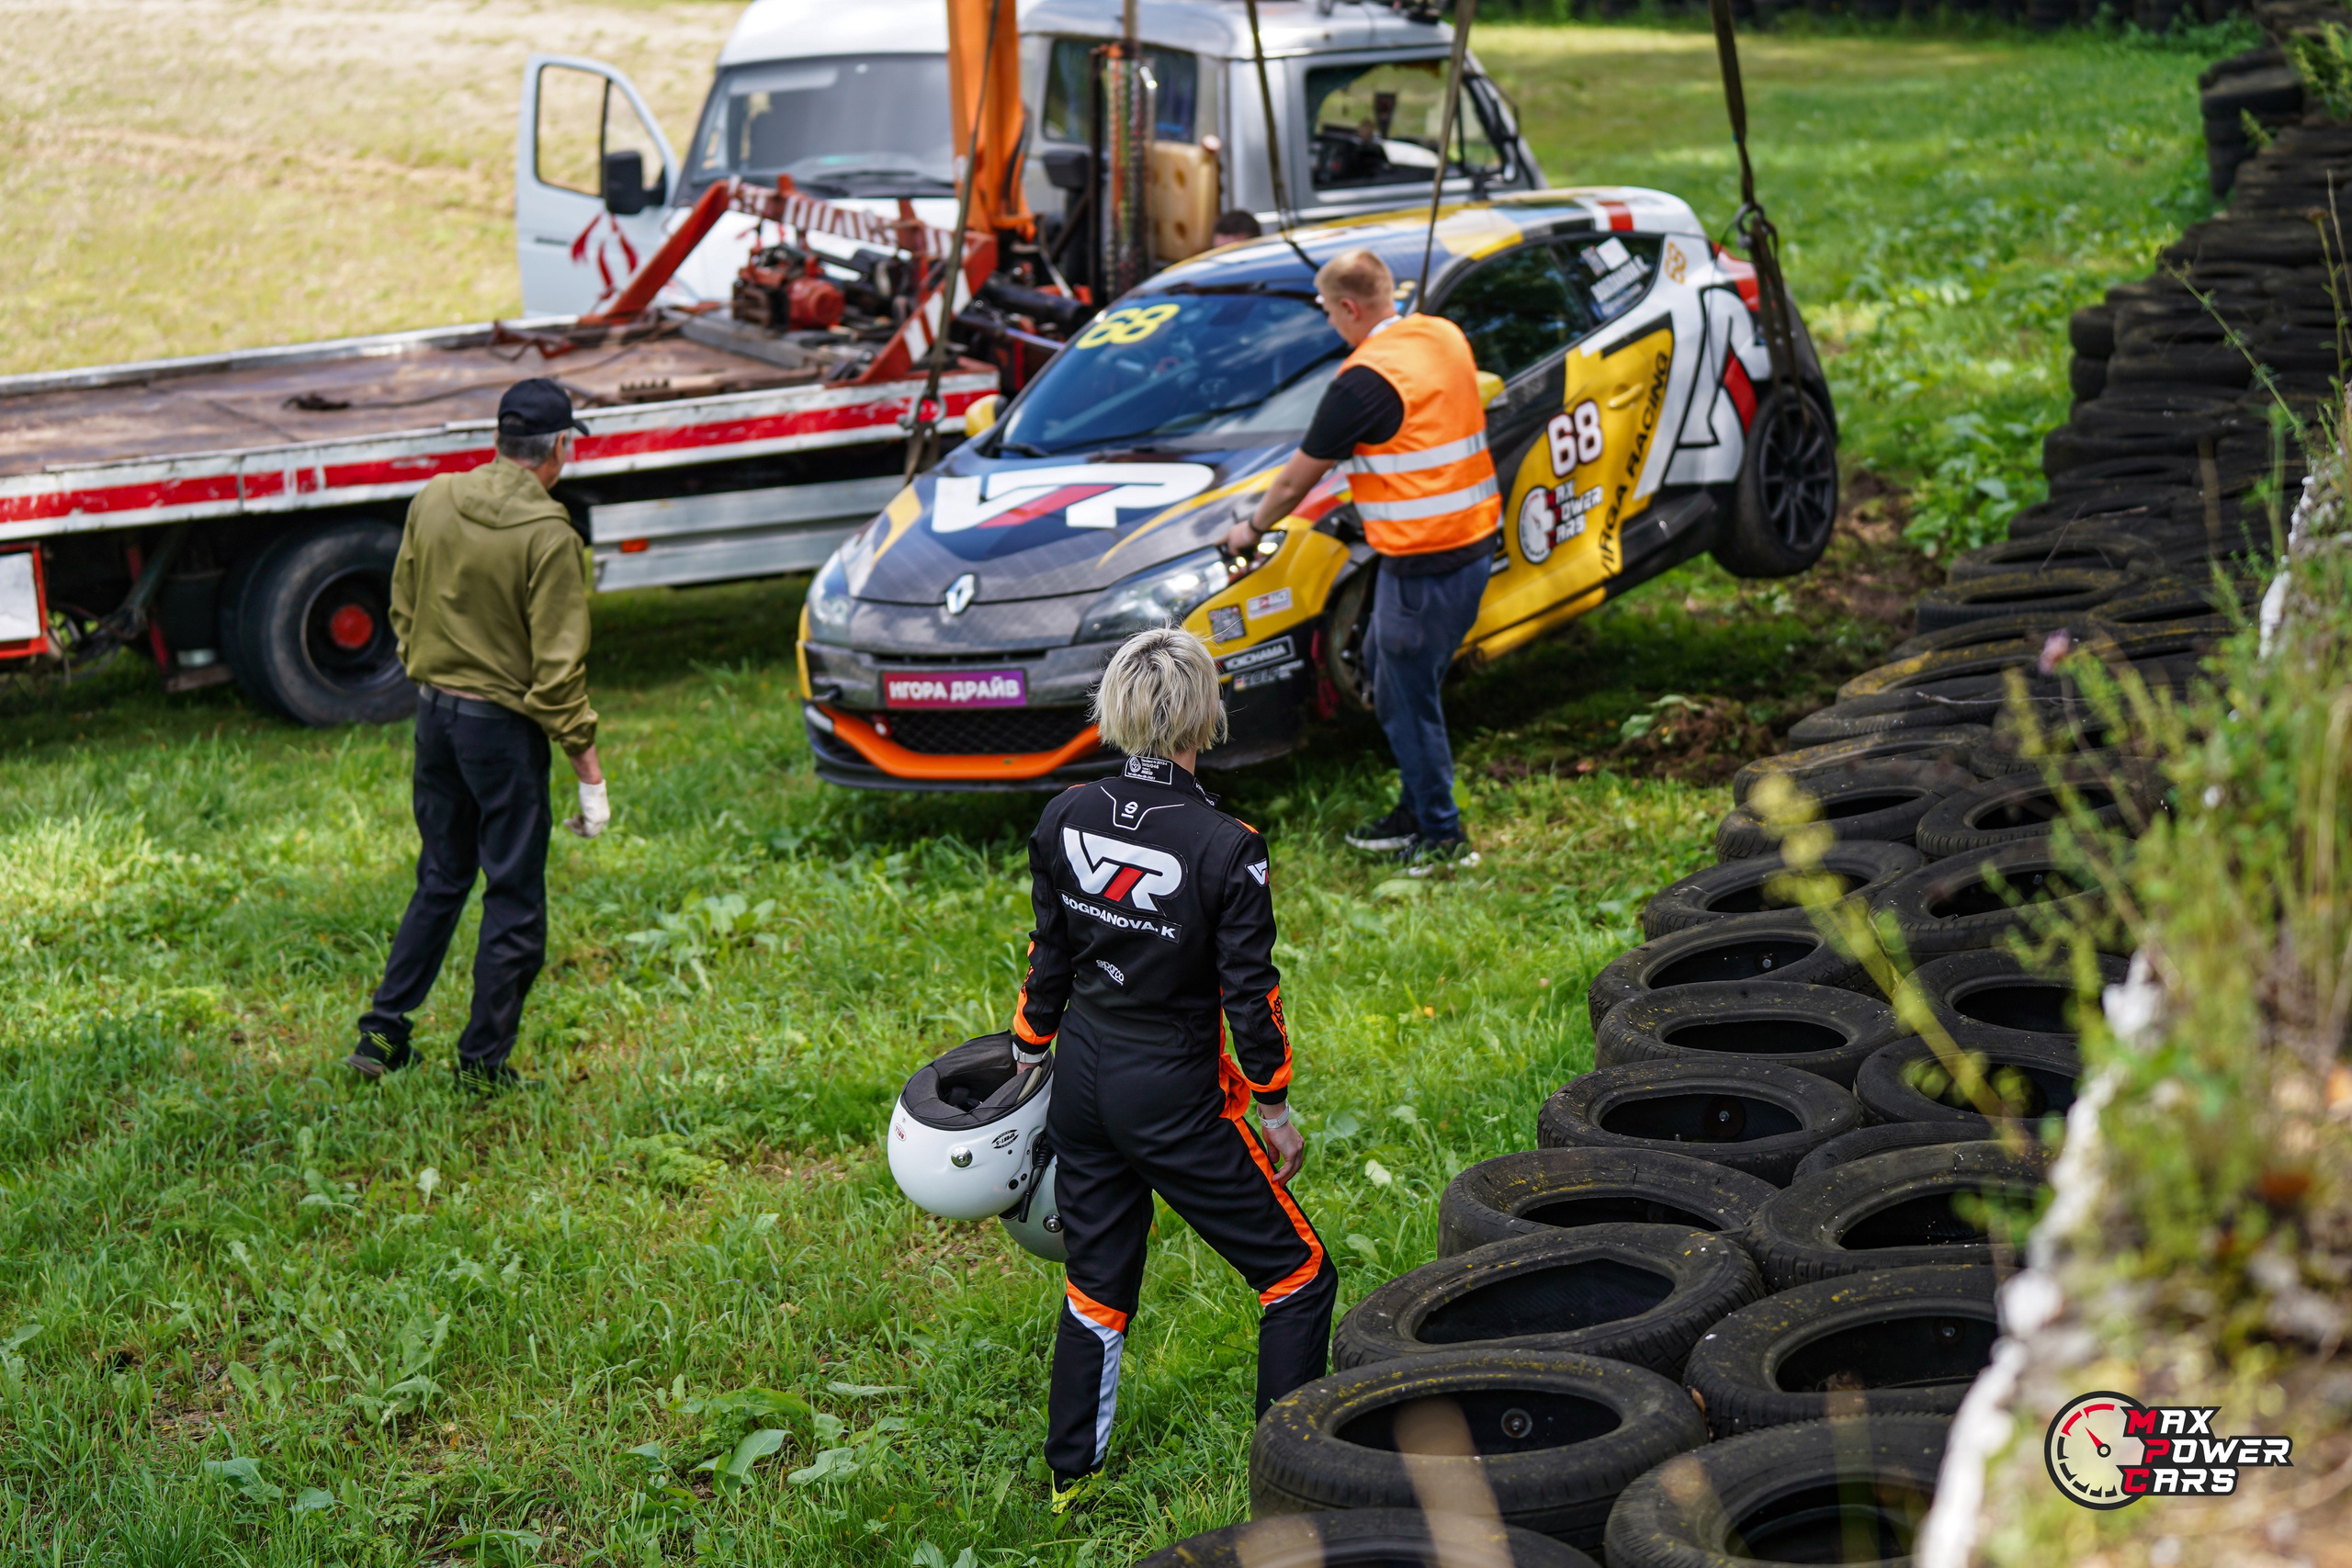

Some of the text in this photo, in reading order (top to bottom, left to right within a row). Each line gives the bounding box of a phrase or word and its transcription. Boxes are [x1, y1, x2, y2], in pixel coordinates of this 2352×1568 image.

[1076, 303, 1181, 349] 68
[1626, 351, 1669, 478] RACING
[1547, 400, 1603, 477] 68
[1554, 485, 1603, 526] POWER
[1224, 644, 1287, 671] YOKOHAMA
[888, 675, 1021, 703] ИГОРА ДРАЙВ
[1247, 860, 1268, 885] V
